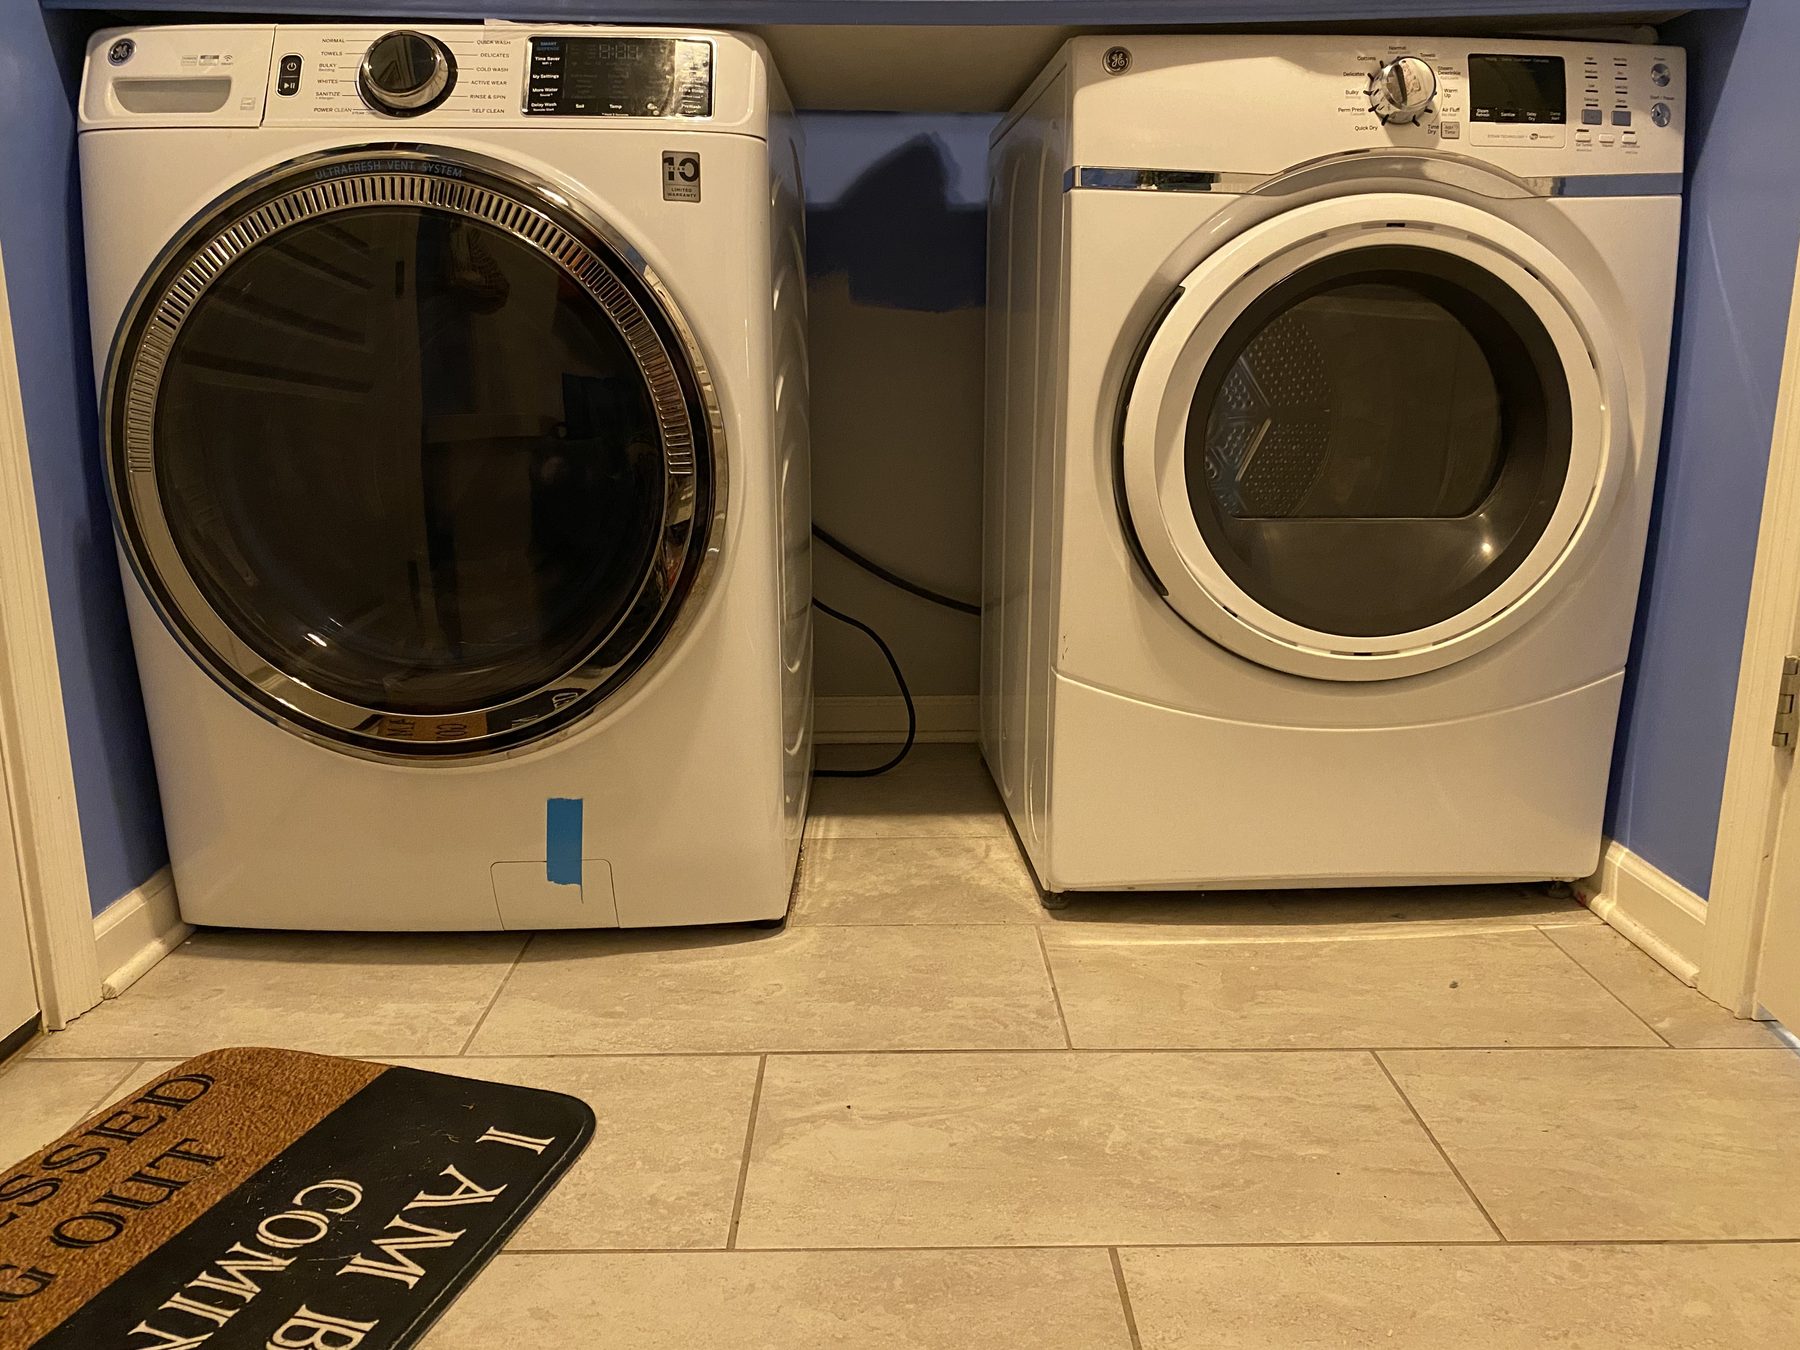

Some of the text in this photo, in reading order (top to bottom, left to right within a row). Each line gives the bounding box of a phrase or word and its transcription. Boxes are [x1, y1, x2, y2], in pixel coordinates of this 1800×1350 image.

[315, 160, 463, 180] ULTRAFRESH VENT SYSTEM
[663, 156, 700, 183] 10
[0, 1073, 215, 1229] SSED
[475, 1126, 556, 1156] I
[50, 1137, 225, 1249] OUT
[336, 1164, 508, 1290] AM
